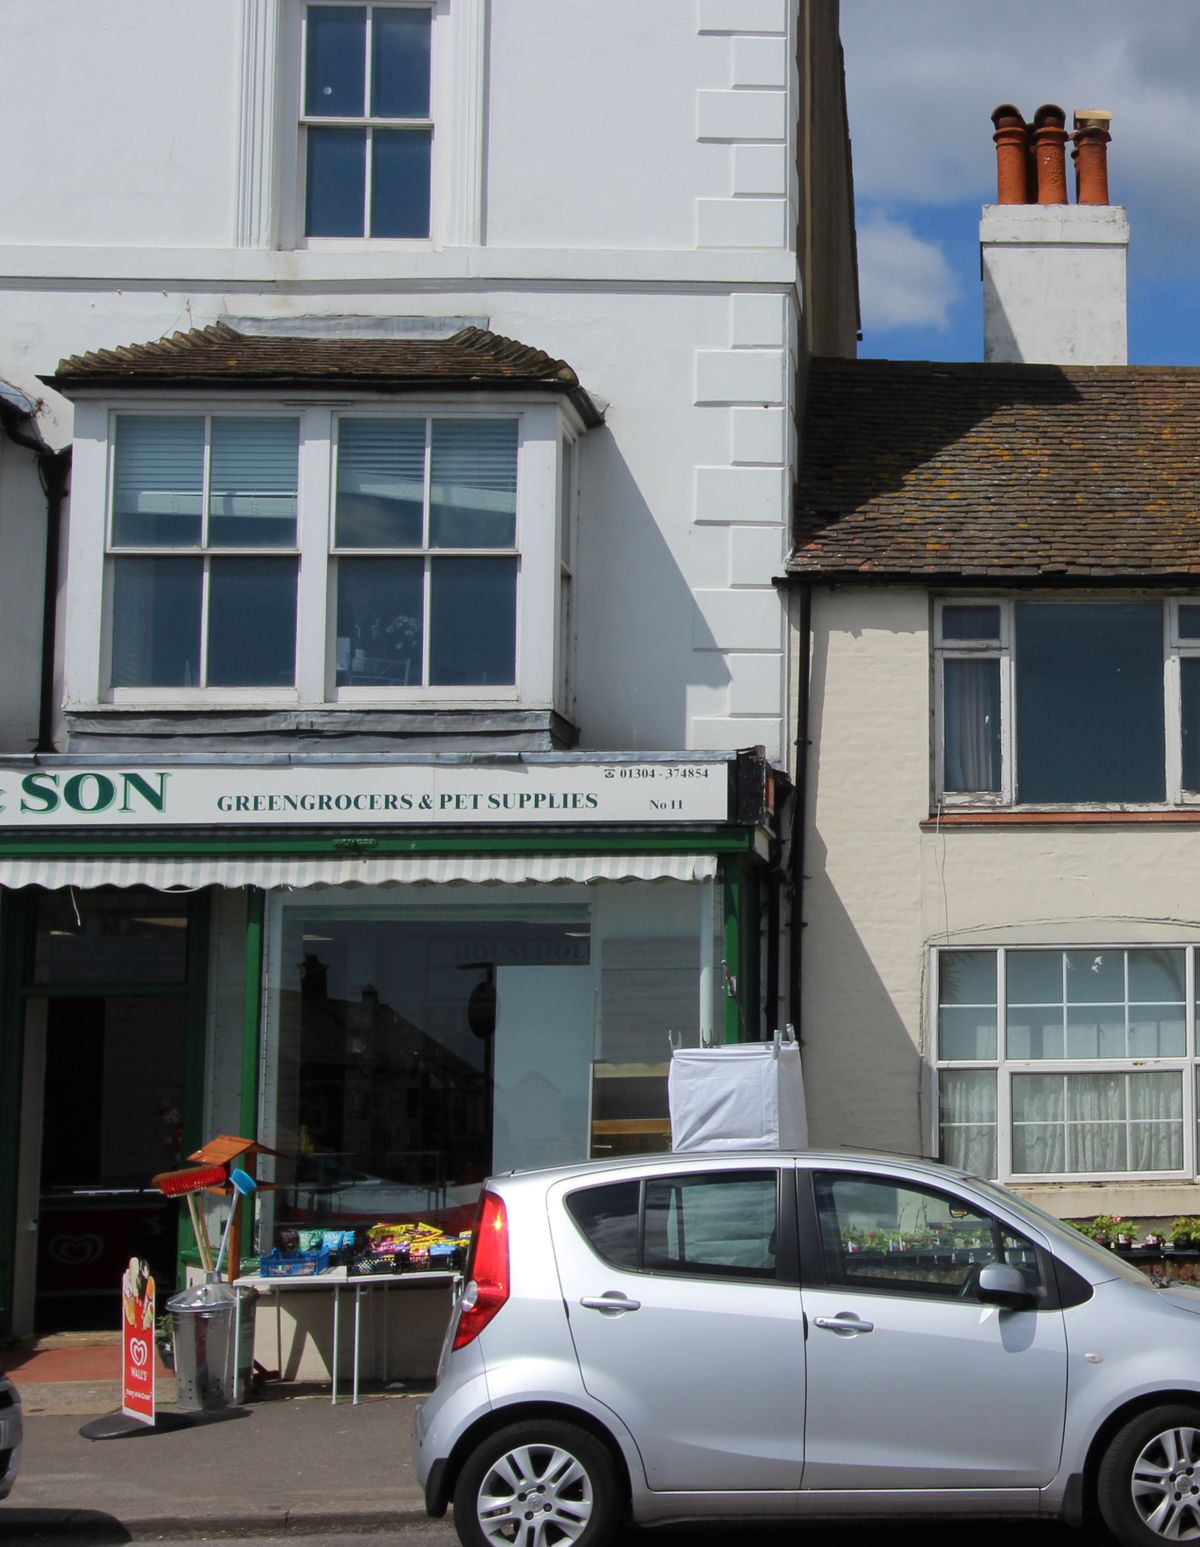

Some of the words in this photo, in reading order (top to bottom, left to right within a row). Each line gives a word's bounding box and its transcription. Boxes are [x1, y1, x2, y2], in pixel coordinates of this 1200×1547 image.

[619, 768, 656, 779] 01304
[665, 768, 709, 780] 374854
[20, 772, 171, 815] SON
[217, 793, 413, 813] GREENGROCERS
[417, 793, 434, 811] &
[438, 793, 484, 811] PET
[487, 791, 599, 811] SUPPLIES
[649, 799, 667, 811] No
[671, 799, 684, 810] 11
